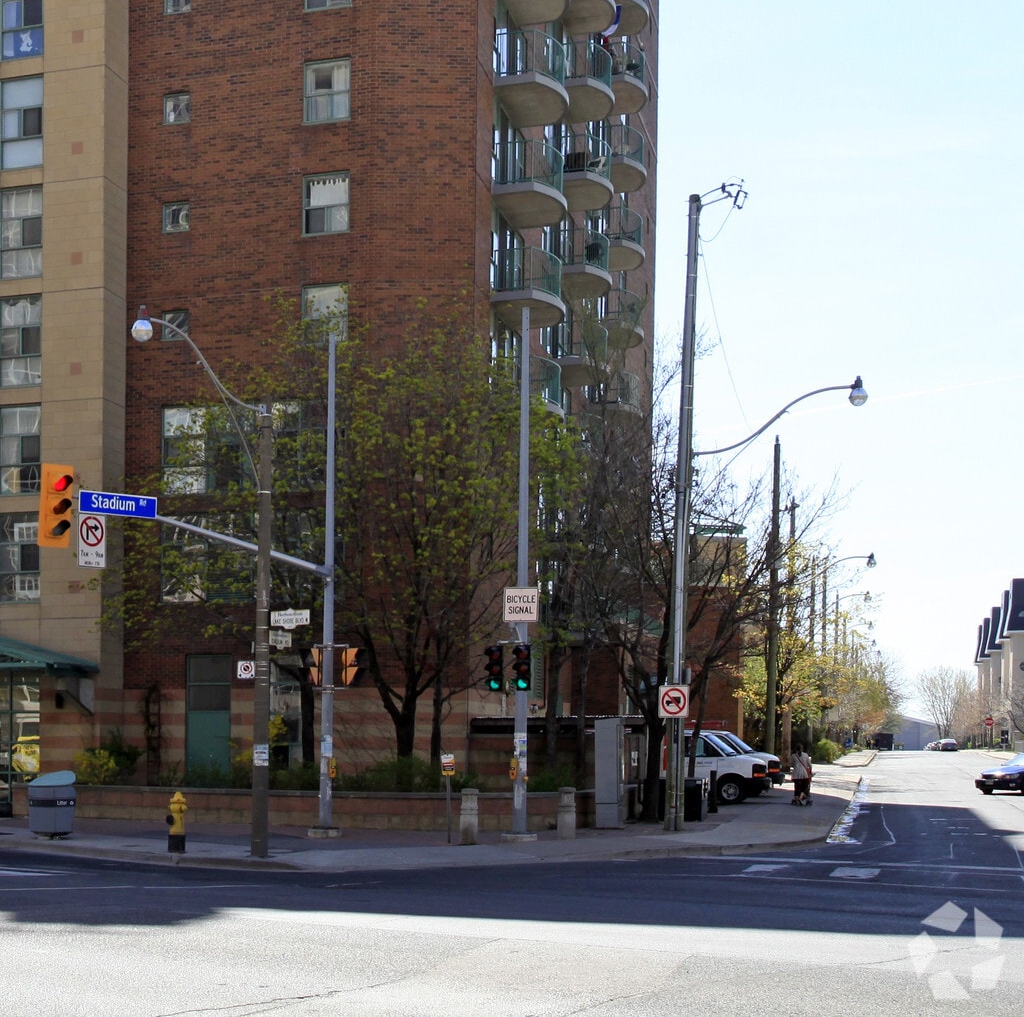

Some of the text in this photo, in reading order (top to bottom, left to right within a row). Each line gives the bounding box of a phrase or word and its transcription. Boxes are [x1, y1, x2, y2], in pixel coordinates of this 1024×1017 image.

[91, 494, 147, 512] Stadium Rd
[507, 594, 536, 603] BICYCLE
[508, 606, 534, 614] SIGNAL
